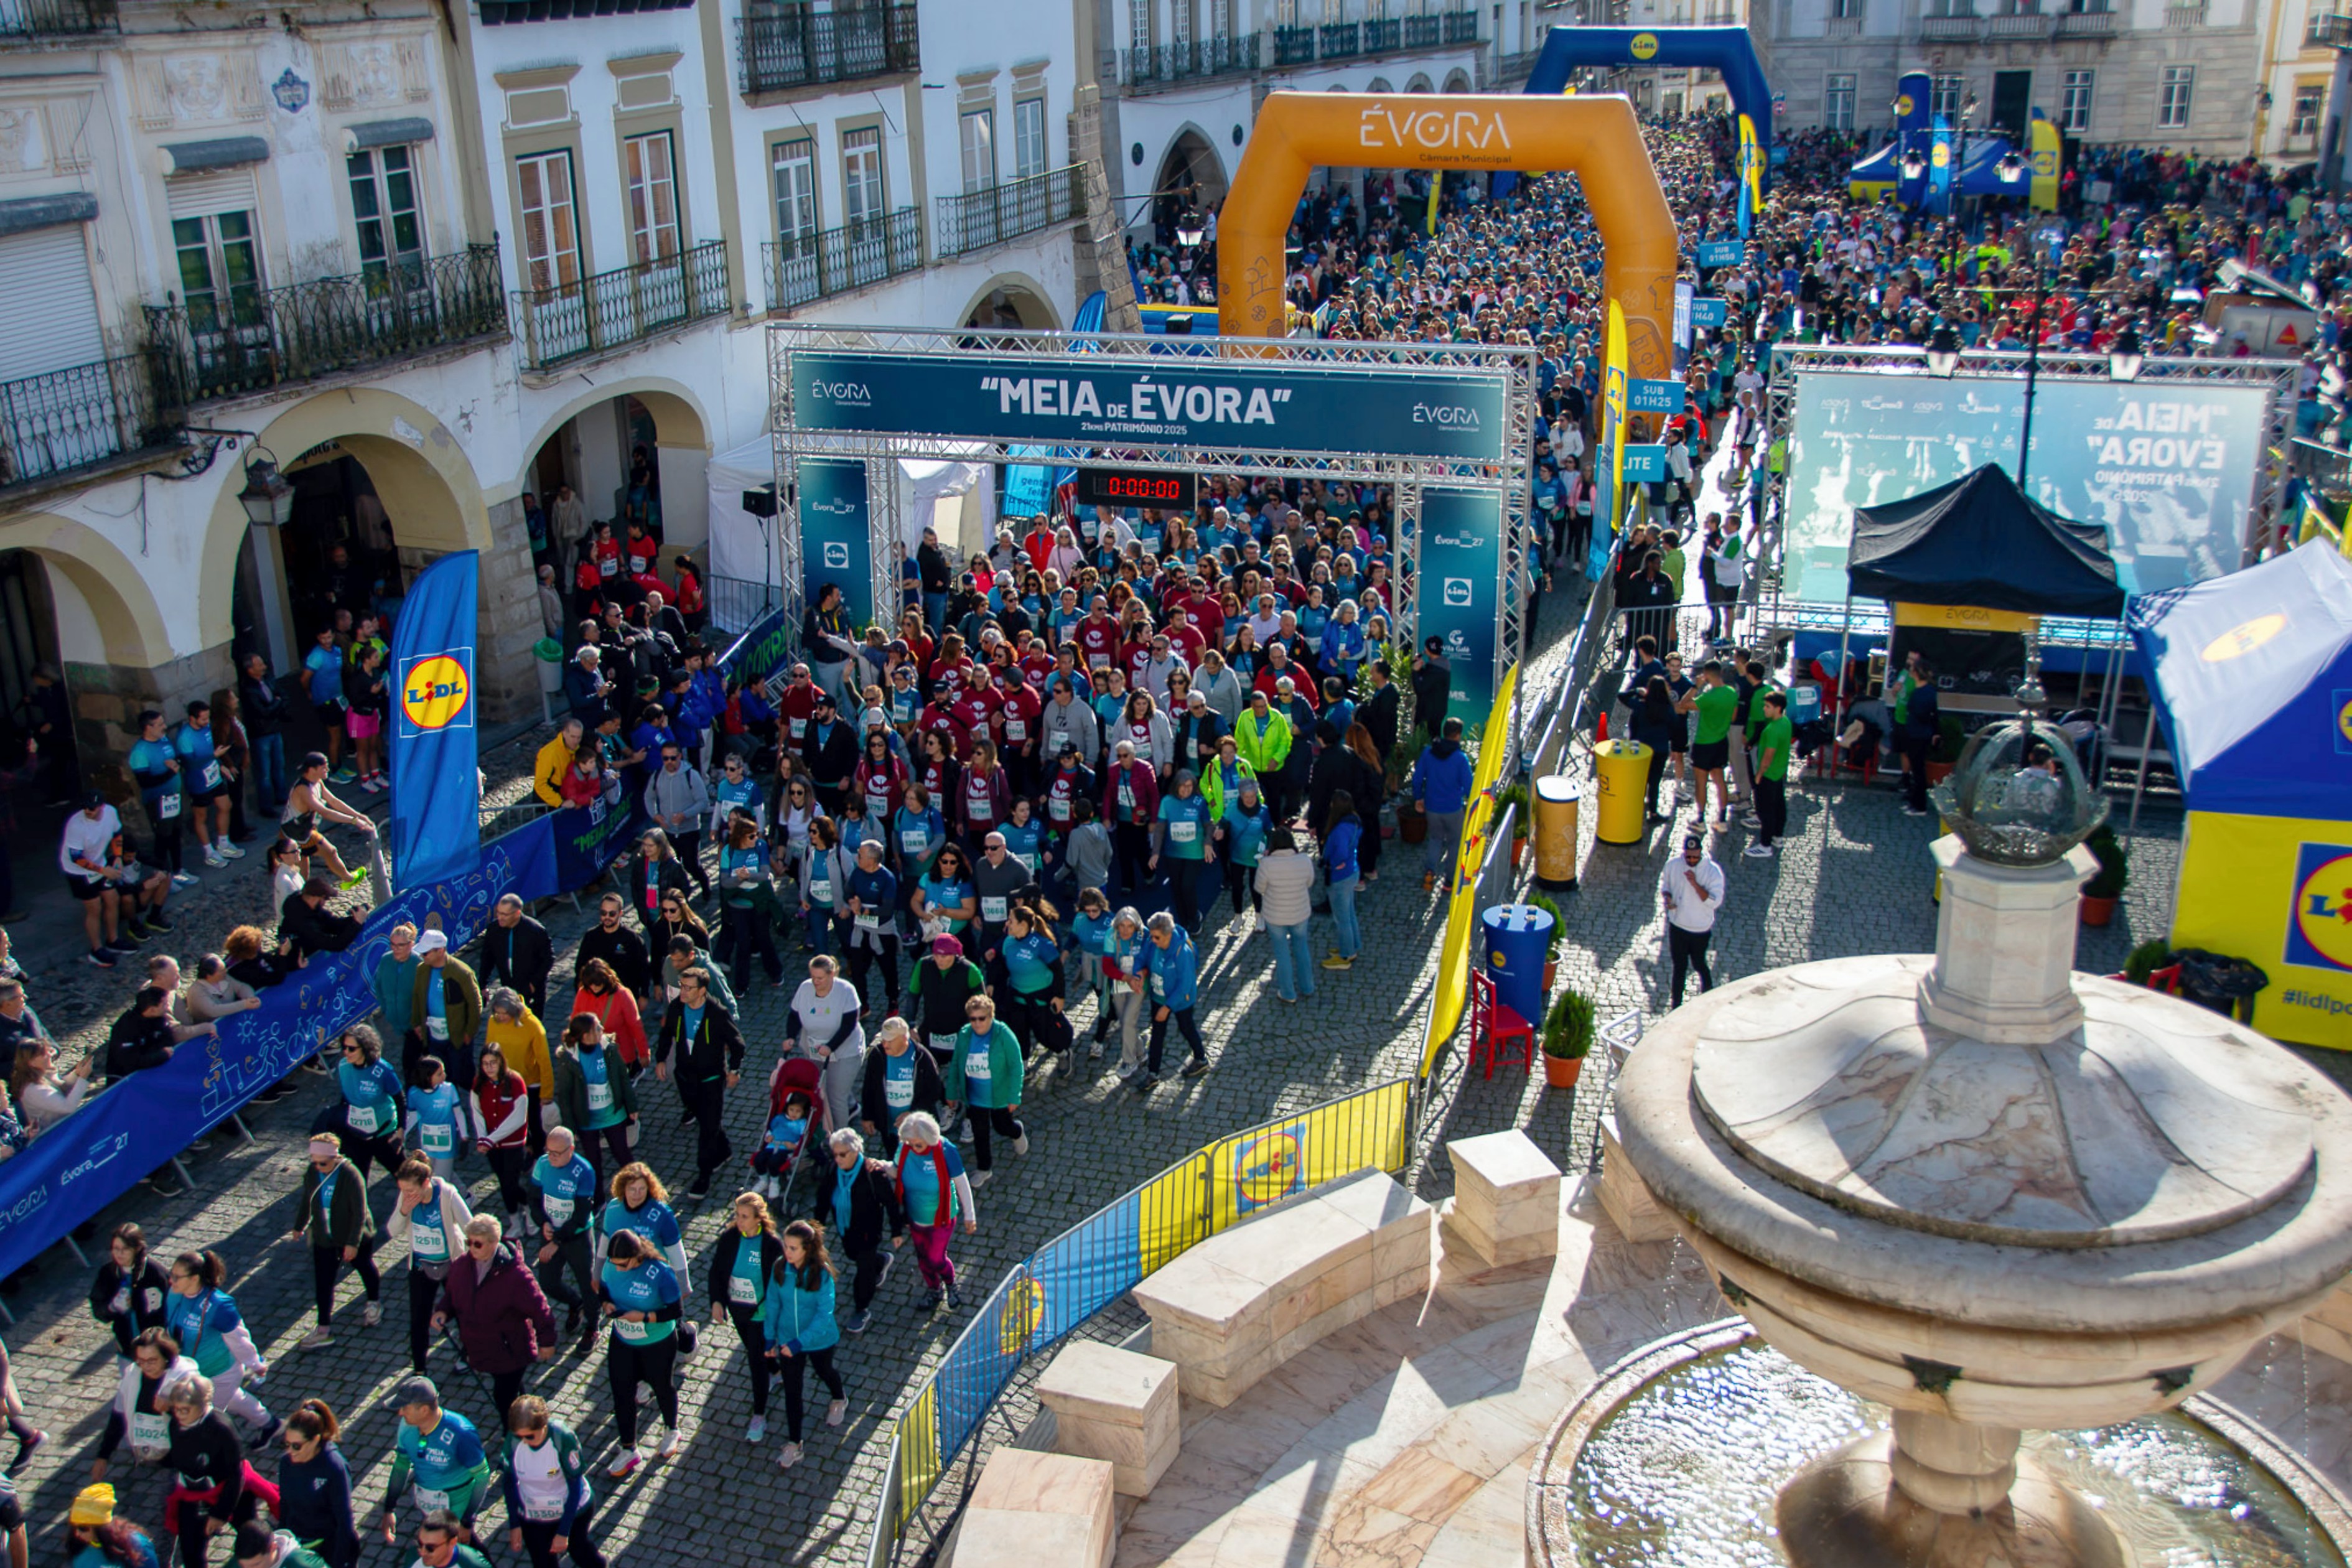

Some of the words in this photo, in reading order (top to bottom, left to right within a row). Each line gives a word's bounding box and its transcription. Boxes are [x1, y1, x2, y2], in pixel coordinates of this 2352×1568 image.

[1360, 103, 1511, 149] ÉVORA
[1419, 153, 1460, 162] Câmara
[1462, 154, 1512, 163] Municipal
[812, 379, 871, 399] ÉVORA
[1643, 385, 1664, 395] SUB
[1634, 396, 1671, 408] 01H25
[1107, 403, 1128, 419] DE
[1412, 402, 1480, 425] ÉVORA
[1104, 422, 1163, 434] PATRIMÓNIO
[1164, 424, 1187, 435] 2025
[1109, 477, 1180, 498] 0:00:00
